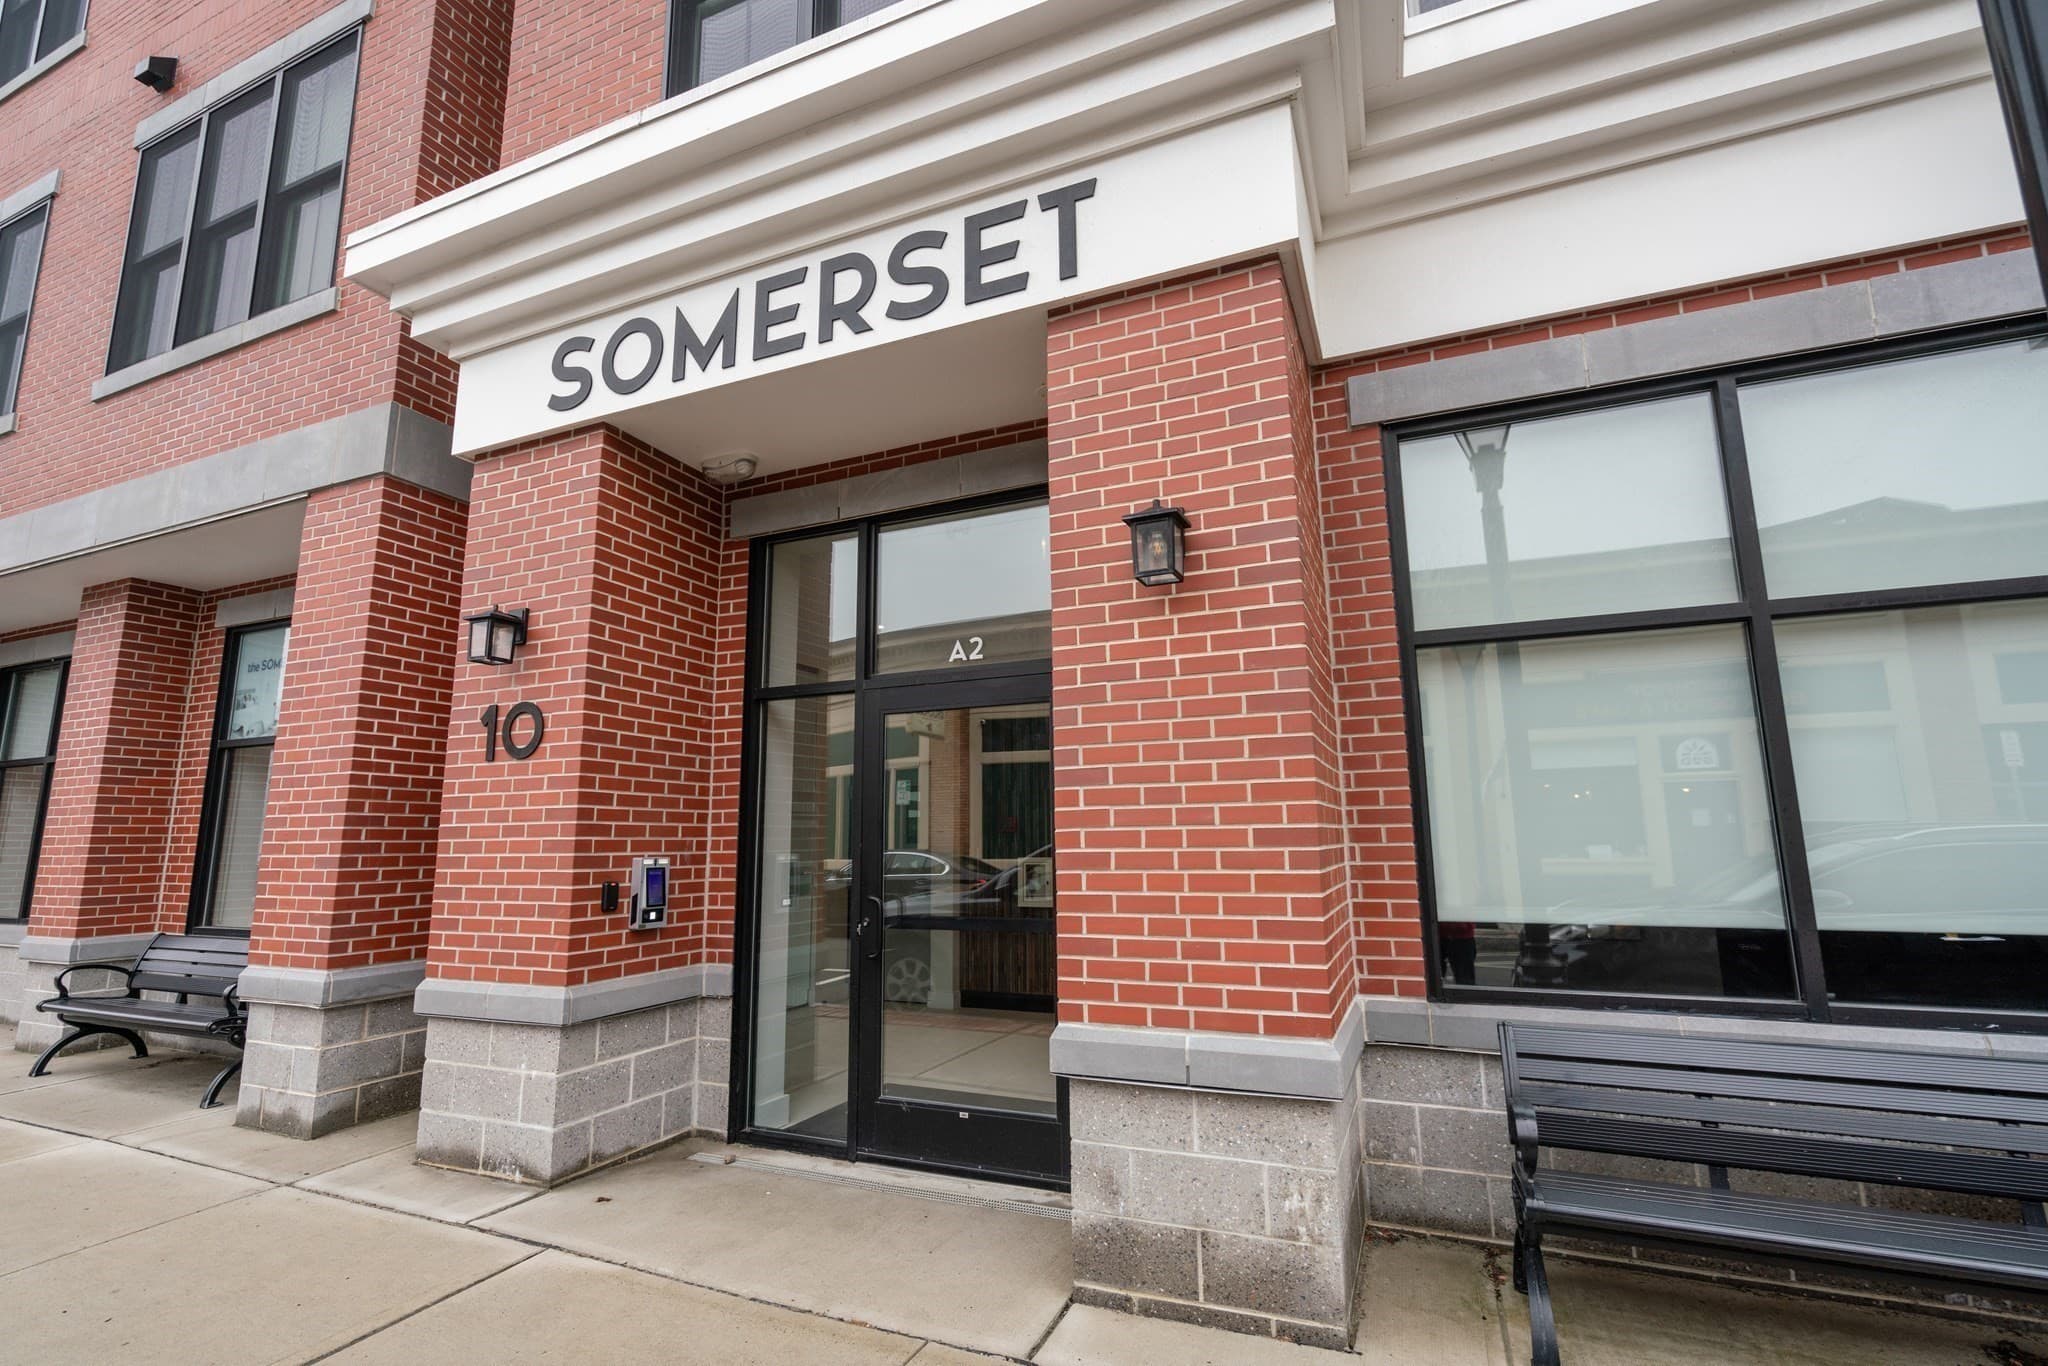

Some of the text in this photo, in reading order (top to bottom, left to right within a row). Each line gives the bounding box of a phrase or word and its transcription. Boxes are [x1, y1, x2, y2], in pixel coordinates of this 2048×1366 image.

[547, 178, 1097, 412] SOMERSET
[247, 662, 260, 673] the
[948, 636, 984, 662] A2
[480, 701, 544, 763] 10
